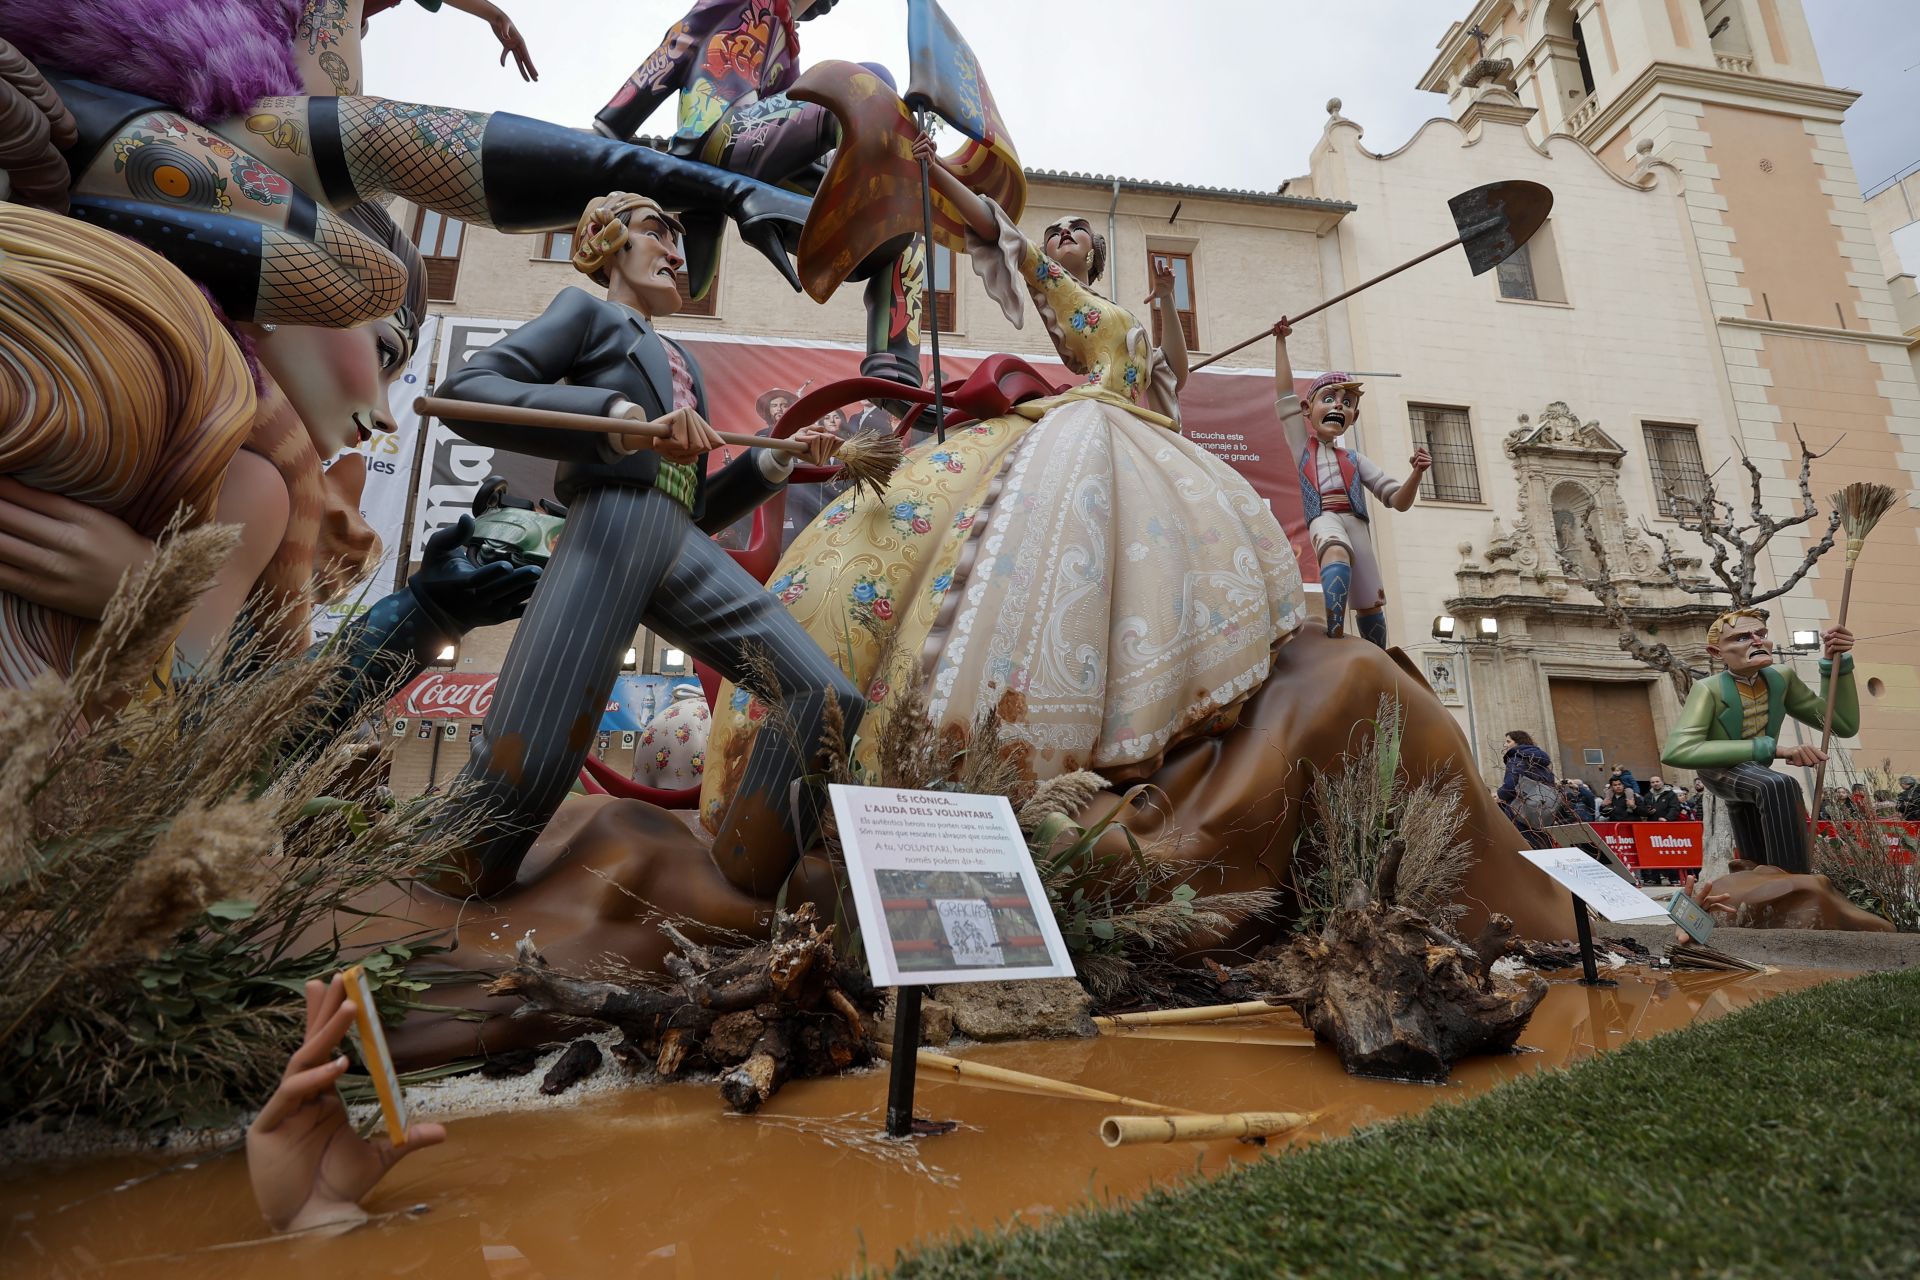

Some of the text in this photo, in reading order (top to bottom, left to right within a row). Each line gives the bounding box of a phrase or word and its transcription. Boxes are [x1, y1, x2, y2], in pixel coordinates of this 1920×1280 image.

[1190, 430, 1244, 441] Escucha este
[1196, 442, 1232, 452] omenaje
[1240, 442, 1248, 451] lo
[1230, 453, 1260, 462] grande
[896, 792, 908, 803] ÉS
[864, 804, 994, 819] L'AJUDA DELS VOLUNTARIS
[937, 822, 959, 830] porten
[895, 831, 909, 839] que
[874, 842, 883, 850] A
[1650, 834, 1693, 848] Mahou
[933, 856, 960, 866] podem
[939, 901, 987, 918] GRACIAS
